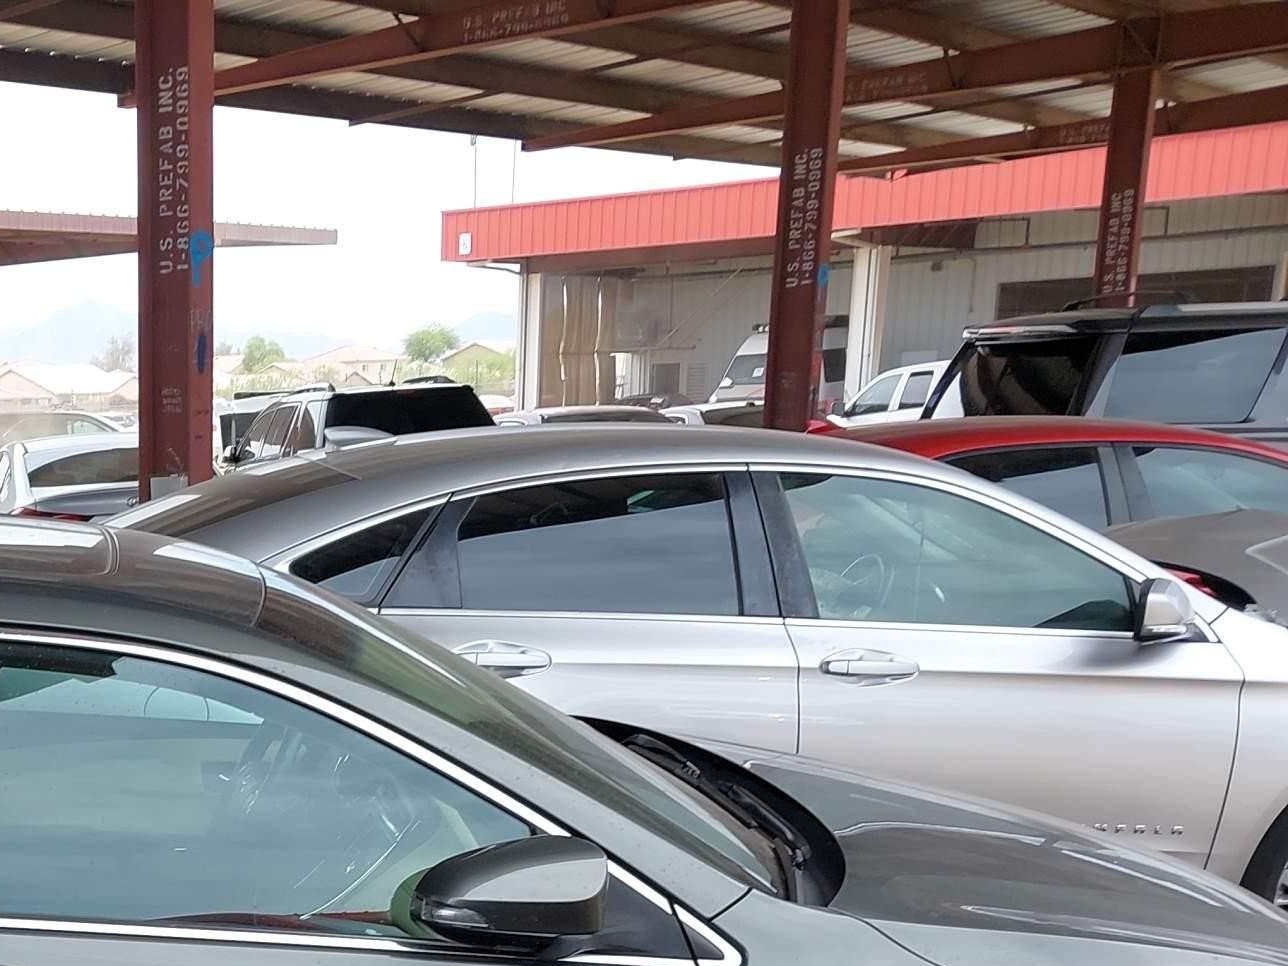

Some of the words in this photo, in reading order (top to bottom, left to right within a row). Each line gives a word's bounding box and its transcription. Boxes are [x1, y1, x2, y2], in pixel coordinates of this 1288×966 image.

[158, 67, 174, 112] INC.
[159, 125, 174, 217] PREFAB
[175, 66, 190, 272] 1-866-799-0969
[788, 188, 806, 250] PREFAB
[800, 147, 823, 286] 1-866-799-0969
[1104, 217, 1120, 265] PREFAB
[159, 229, 174, 274] U.S.
[785, 257, 800, 288] U.S.
